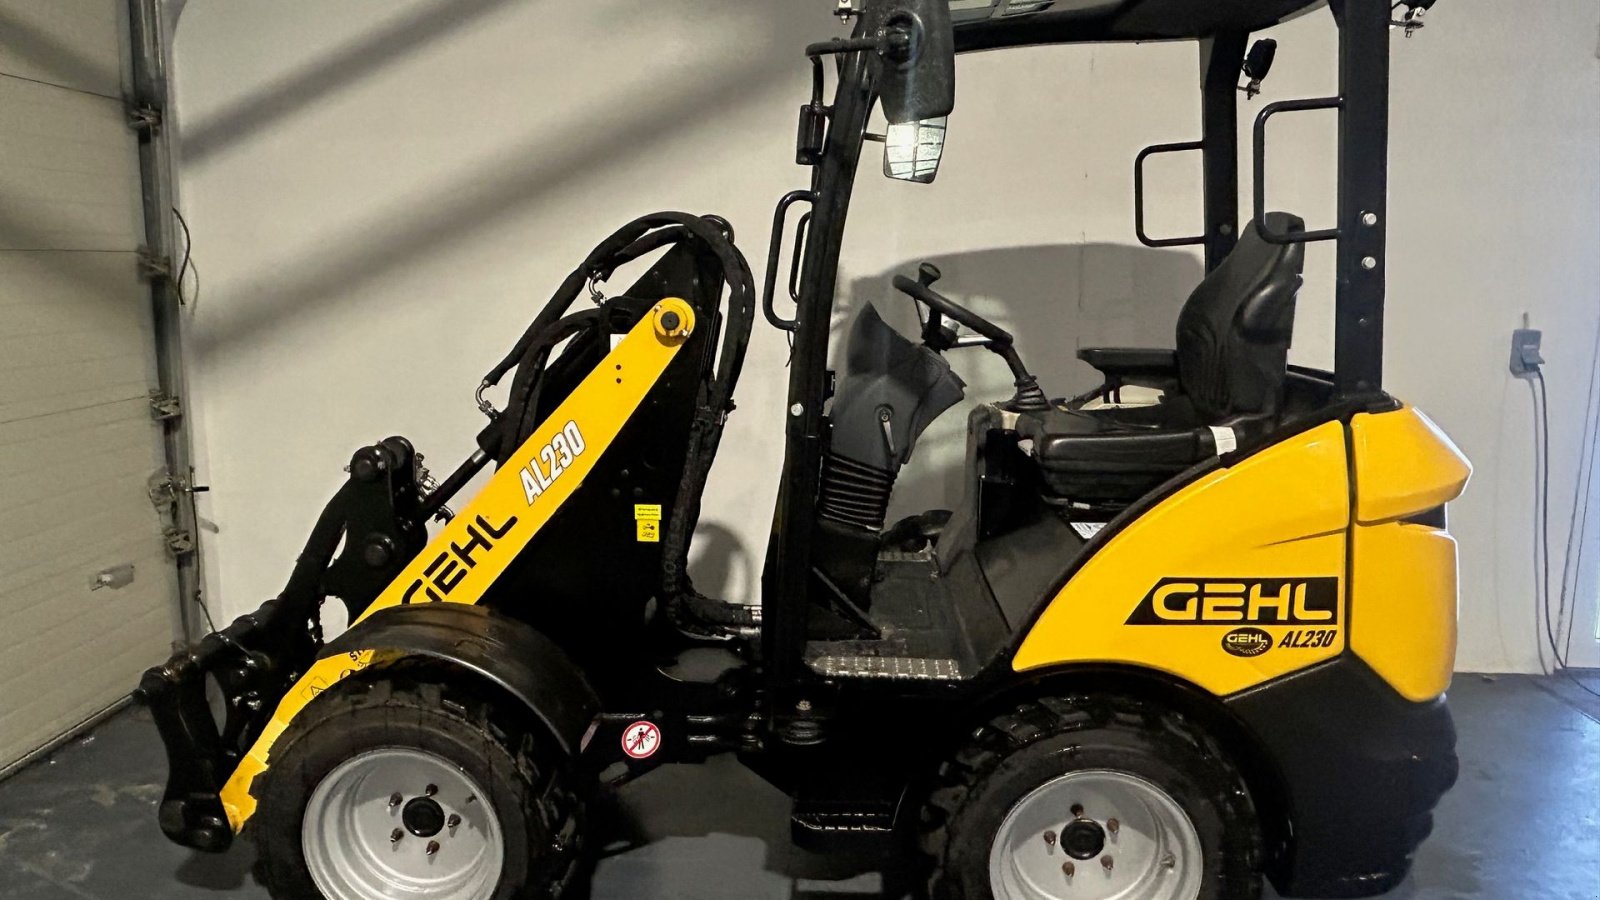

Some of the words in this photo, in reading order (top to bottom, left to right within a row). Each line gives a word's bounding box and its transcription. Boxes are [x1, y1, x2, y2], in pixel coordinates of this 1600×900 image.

[519, 420, 586, 507] AL230
[1152, 583, 1332, 620] GEHL
[1226, 634, 1268, 643] GEHL
[1278, 630, 1337, 648] AL230
